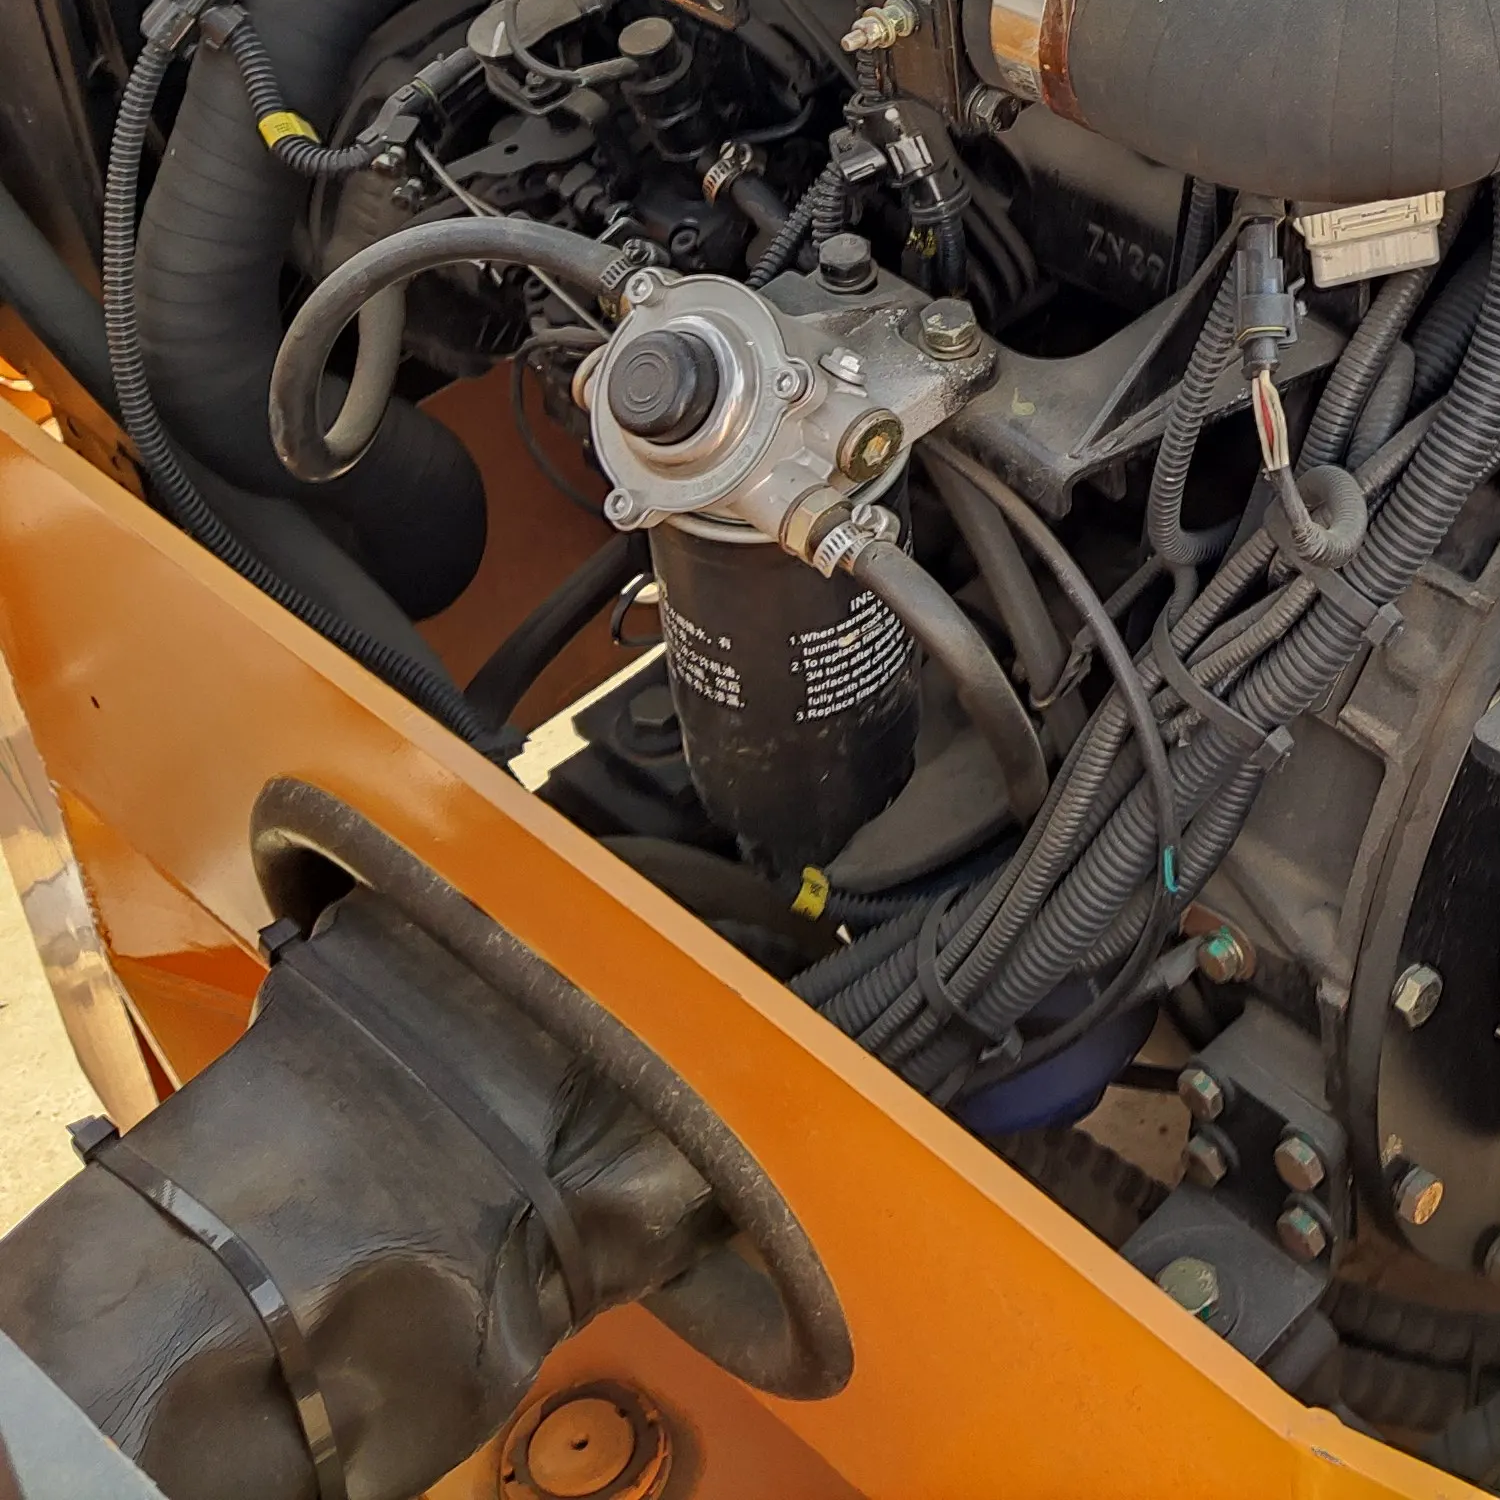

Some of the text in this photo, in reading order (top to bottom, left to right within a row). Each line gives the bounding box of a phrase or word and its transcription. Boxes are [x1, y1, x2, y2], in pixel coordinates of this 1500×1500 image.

[836, 603, 877, 632] warning
[819, 640, 861, 666] replace
[825, 661, 849, 676] turn
[850, 646, 874, 666] after
[807, 673, 850, 694] surface
[851, 660, 872, 678] and
[808, 692, 834, 707] fully
[835, 682, 859, 698] with
